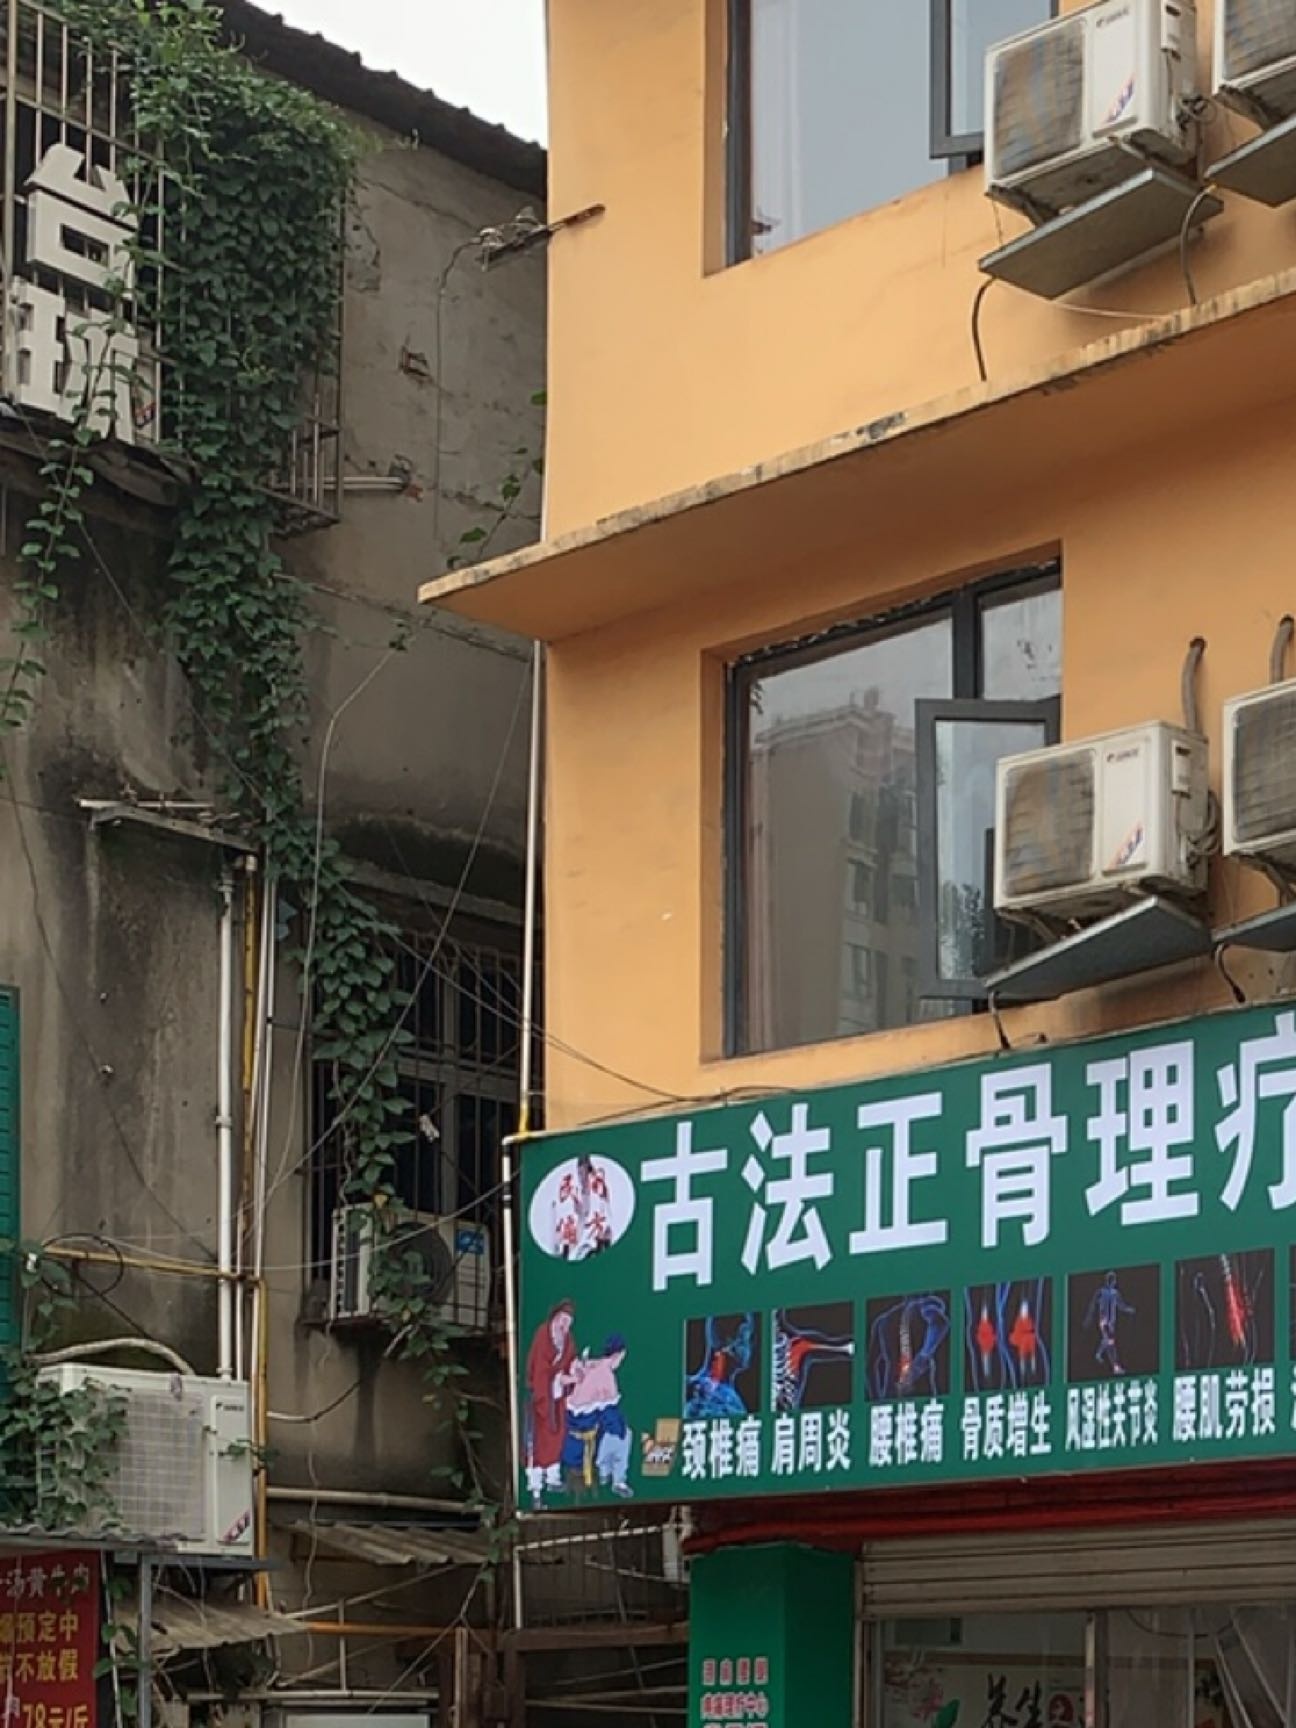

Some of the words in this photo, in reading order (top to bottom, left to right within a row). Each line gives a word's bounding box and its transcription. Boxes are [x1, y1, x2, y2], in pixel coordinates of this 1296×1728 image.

[869, 1398, 945, 1467] 腰椎痛
[960, 1390, 1052, 1461] 骨质增生
[1064, 1380, 1158, 1450] 风湿性关节炎
[1173, 1367, 1276, 1442] 腰肌劳损
[682, 1415, 762, 1480] 颈椎痛
[771, 1405, 851, 1474] 肩周炎
